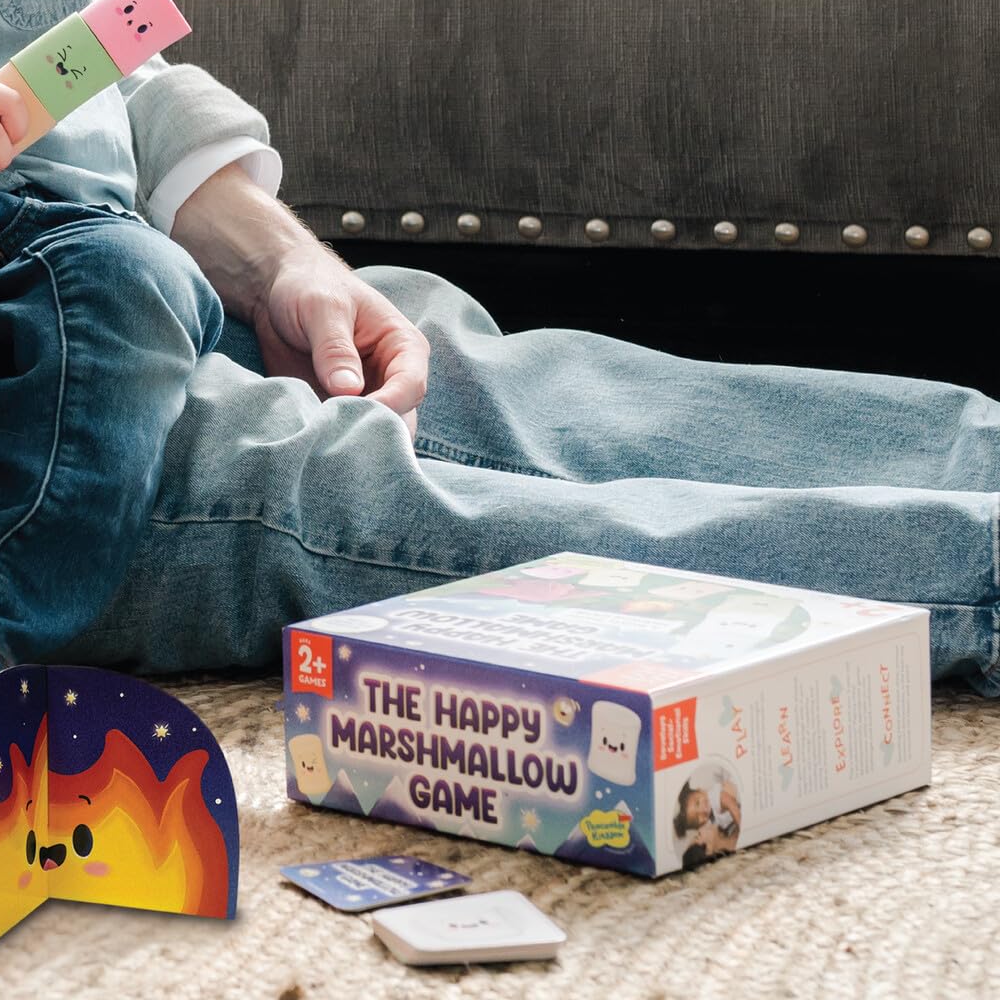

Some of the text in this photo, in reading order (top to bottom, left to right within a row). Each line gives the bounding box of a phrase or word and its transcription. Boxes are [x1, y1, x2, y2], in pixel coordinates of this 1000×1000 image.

[298, 645, 327, 674] 2+
[298, 674, 327, 688] GAMES
[363, 678, 541, 744] THE HAPPY
[731, 705, 748, 760] PLAY
[830, 695, 847, 773] EXPLORE
[880, 664, 894, 745] CONNECT
[331, 713, 578, 796] MARSHMALLOW
[778, 706, 793, 768] LEARN
[409, 774, 498, 825] GAME
